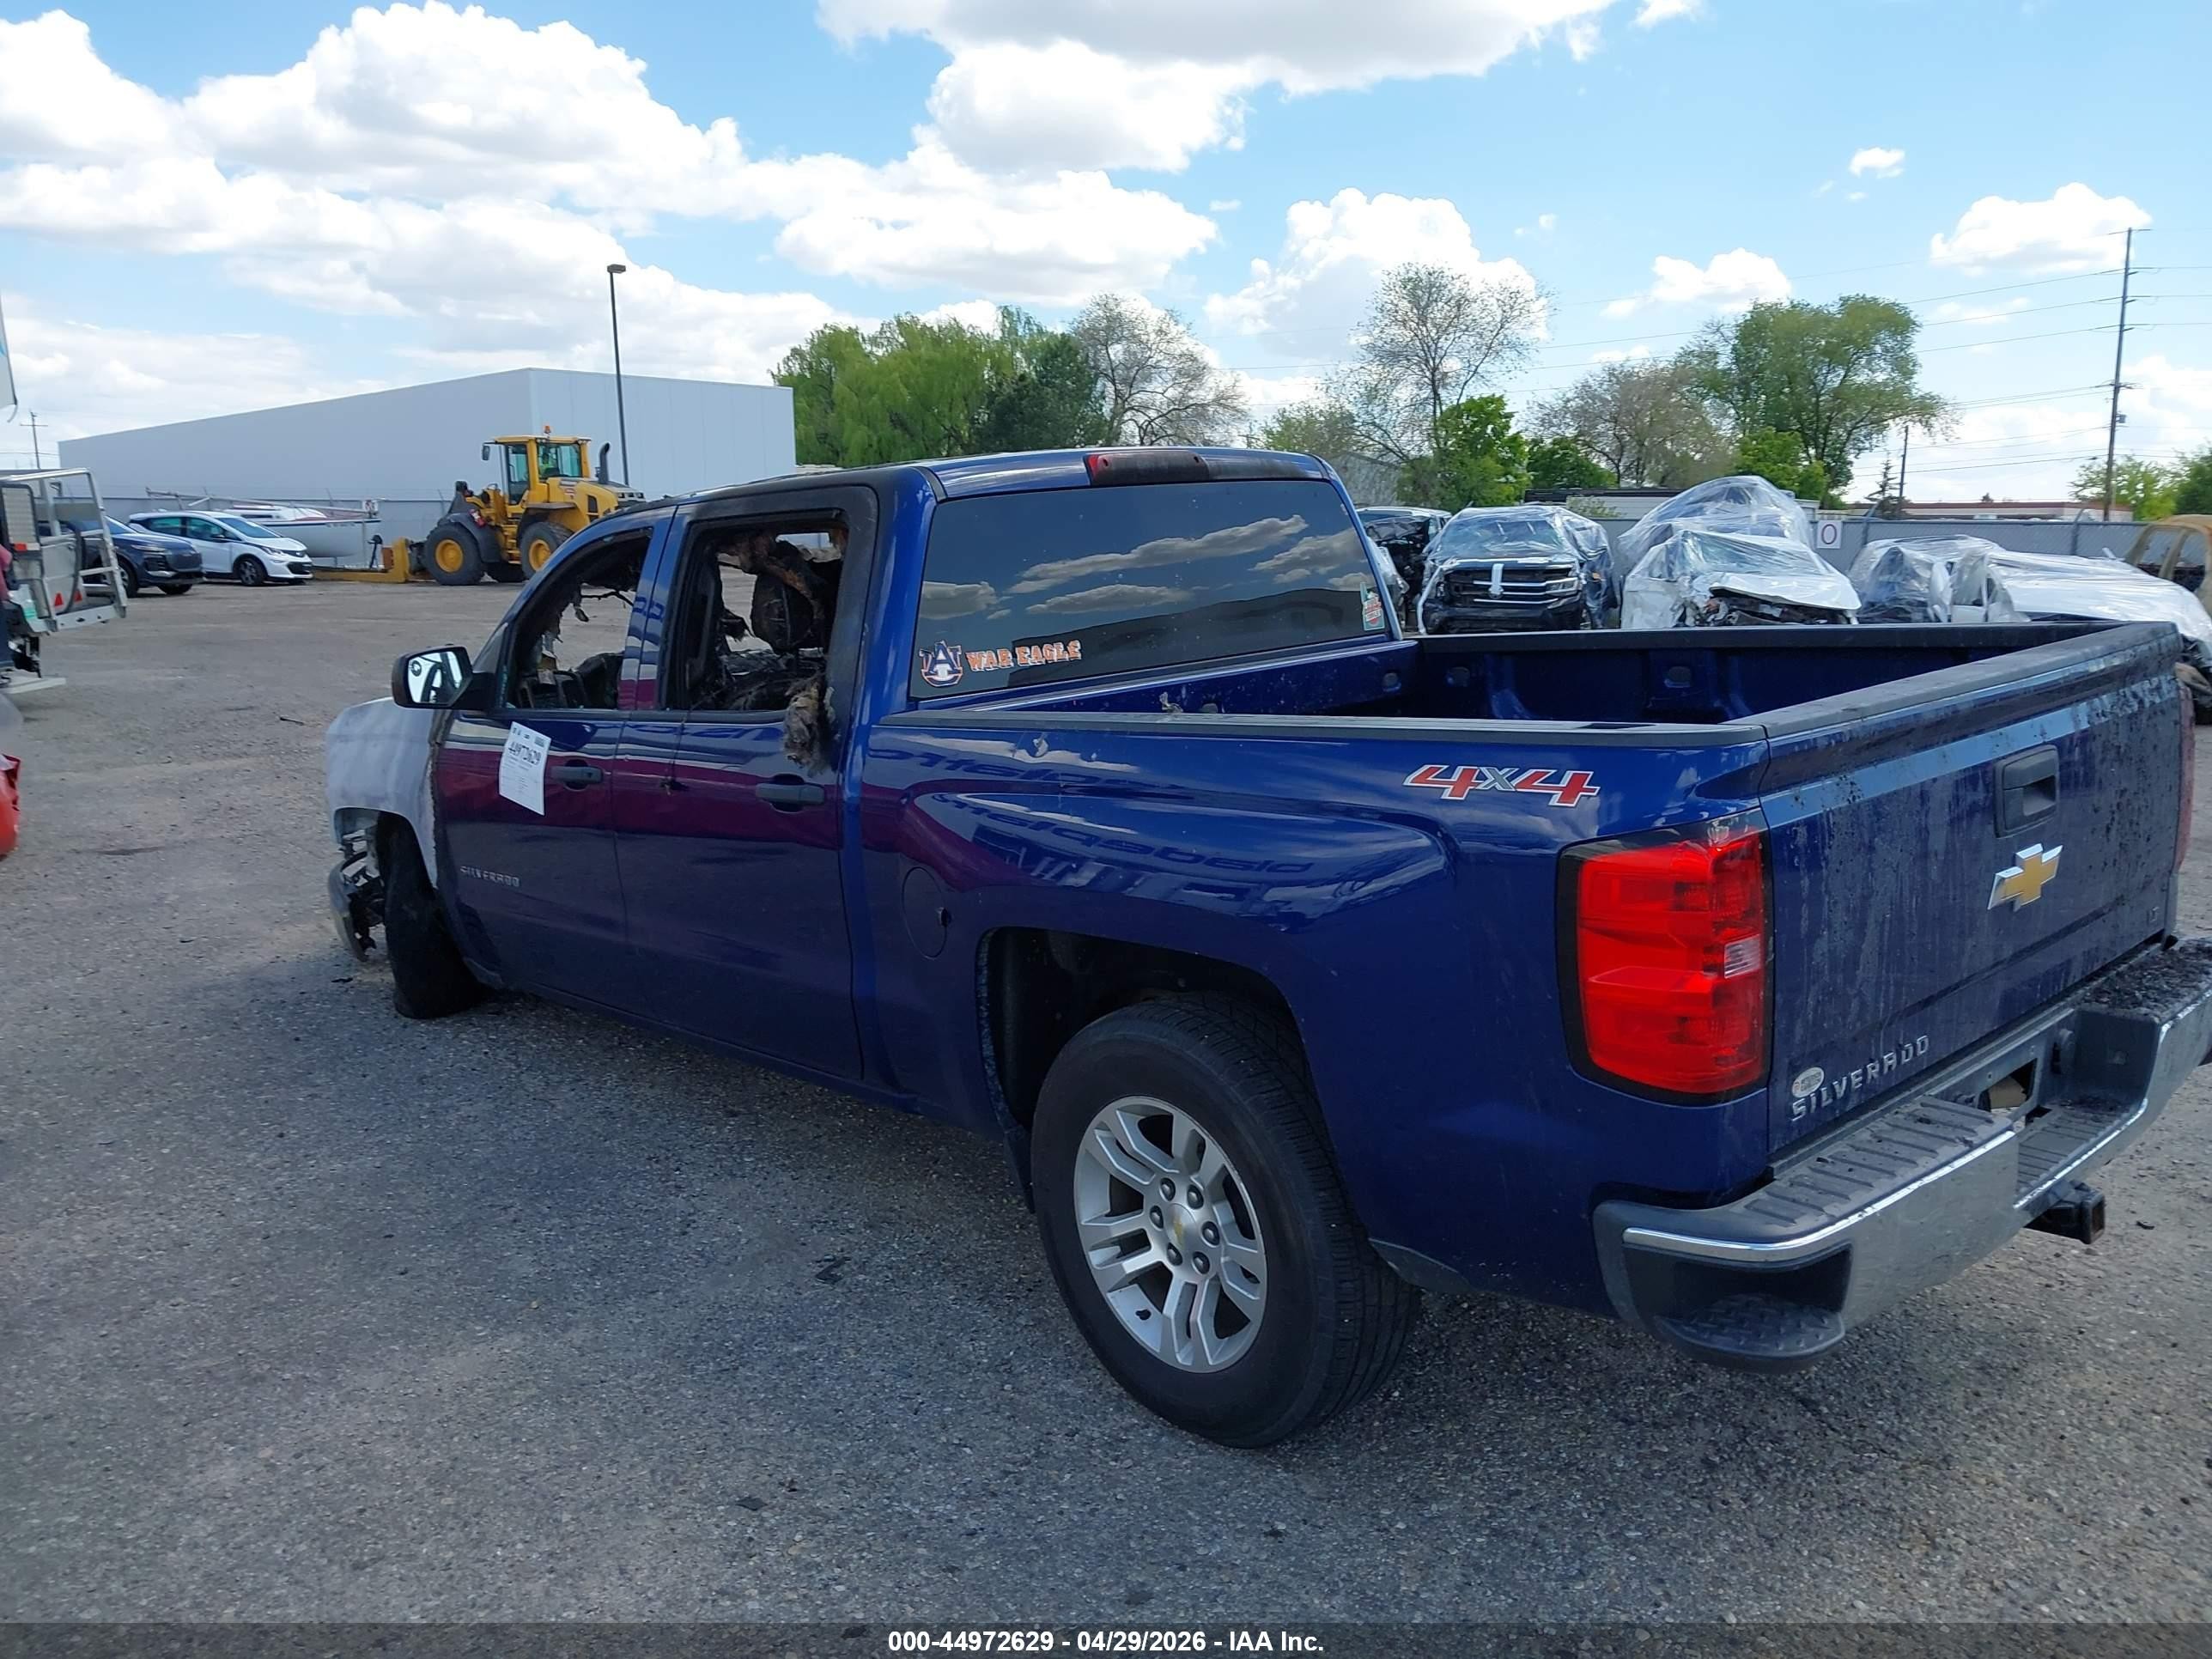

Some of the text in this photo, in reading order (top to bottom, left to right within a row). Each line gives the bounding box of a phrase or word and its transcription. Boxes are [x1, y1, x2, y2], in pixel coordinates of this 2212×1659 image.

[966, 640, 1082, 672] WAR EAGLE
[1791, 1035, 1929, 1121] SILVERADO
